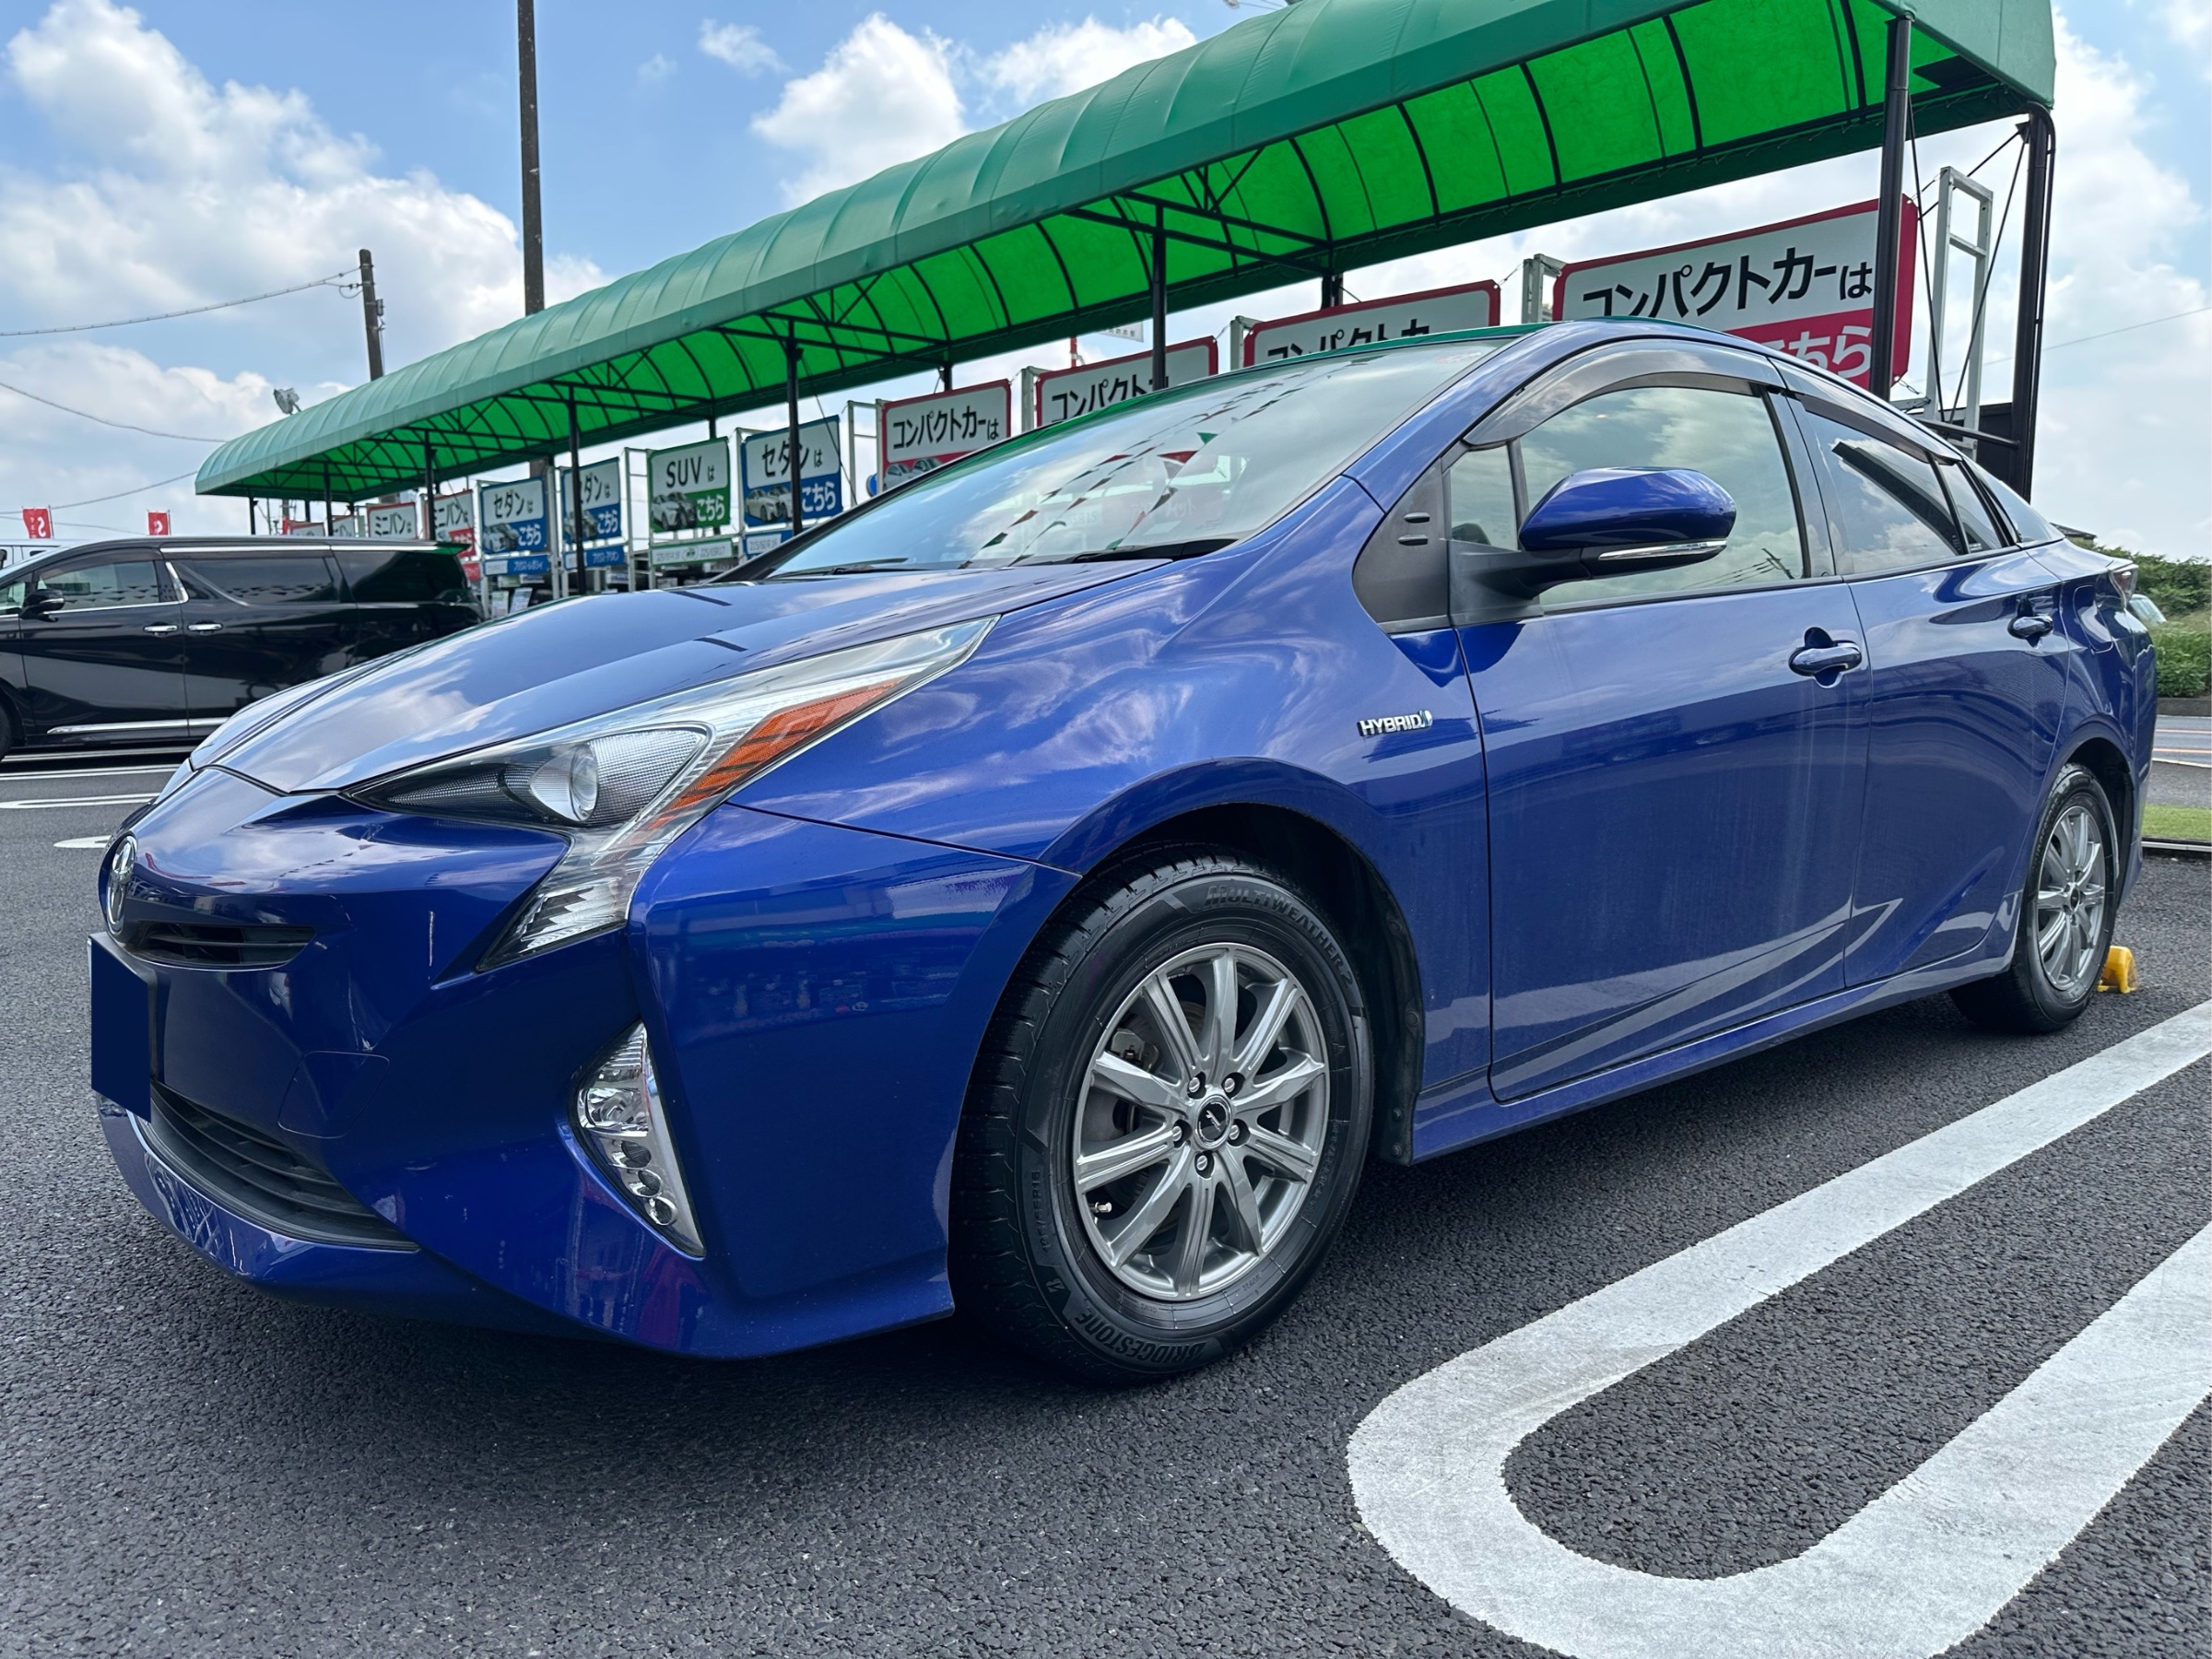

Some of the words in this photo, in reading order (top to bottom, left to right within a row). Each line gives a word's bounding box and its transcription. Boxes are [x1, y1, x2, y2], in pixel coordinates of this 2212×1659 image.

[1761, 325, 1872, 379] ちら
[1051, 373, 1170, 423] コンパクト
[892, 405, 1000, 450] コンパクトカーは
[493, 488, 534, 518] セダンは
[579, 471, 611, 505] ダンは
[801, 481, 836, 513] こちら
[597, 509, 618, 535] こちら
[697, 493, 725, 523] こちら
[518, 523, 542, 547] こちら
[1359, 713, 1422, 735] HYBRID
[1204, 885, 1344, 968] MULTIWEATHER
[1339, 971, 1354, 986] 2
[1074, 1307, 1207, 1364] BRIDGESTONE
